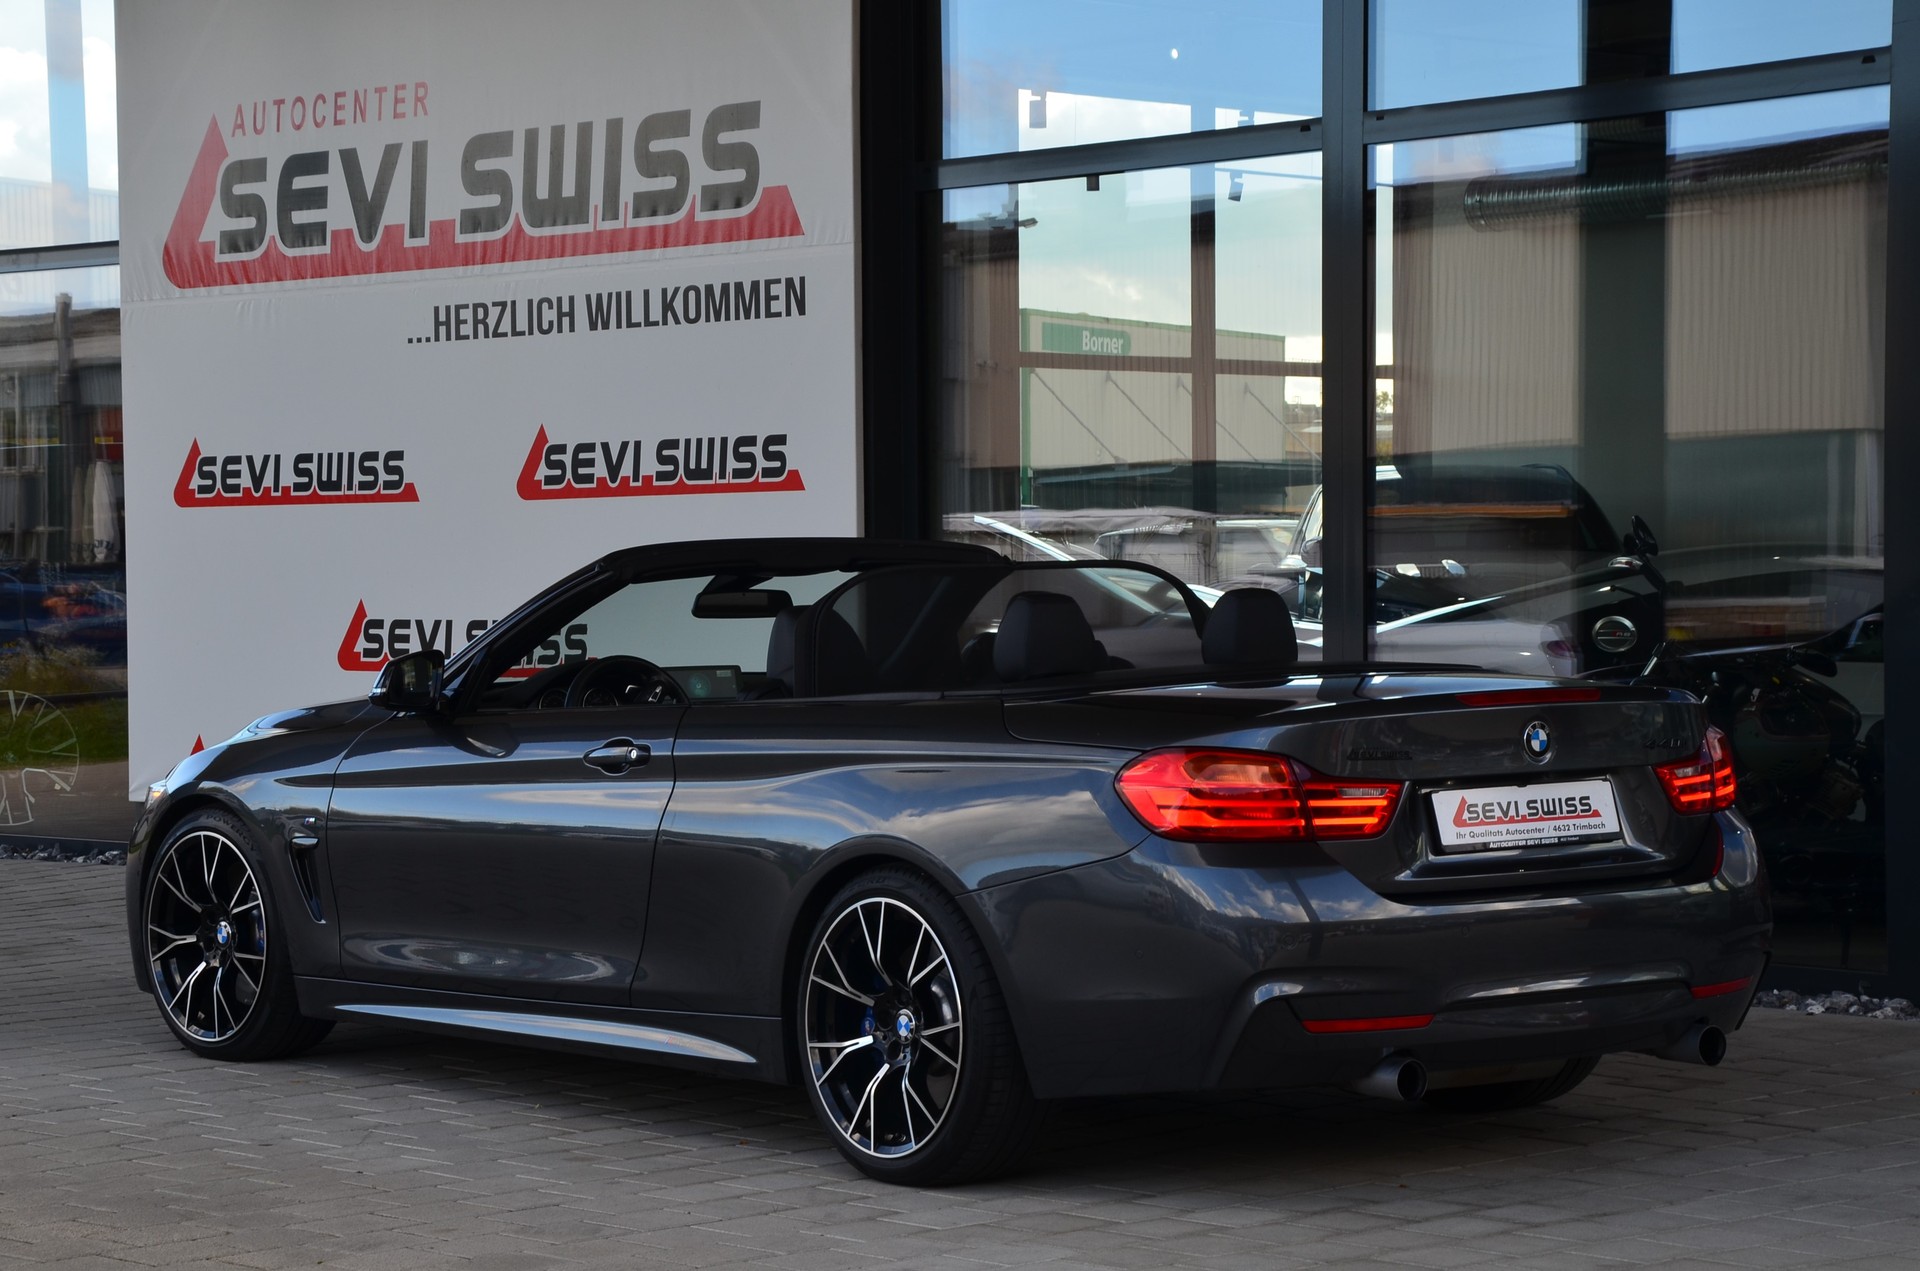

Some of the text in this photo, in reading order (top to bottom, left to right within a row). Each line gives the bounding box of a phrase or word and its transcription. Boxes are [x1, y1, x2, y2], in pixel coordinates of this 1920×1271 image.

[231, 82, 429, 137] AUTOCENTER
[219, 101, 761, 254] SEVI SWISS
[407, 276, 807, 344] ...HERZLICH WILLKOMMEN
[1082, 330, 1124, 353] Borner
[197, 451, 405, 494] SEVI SWISS
[544, 434, 788, 486] SEVI SWISS
[363, 619, 453, 660] SEVI
[1466, 796, 1591, 821] SEVI SWISS
[1456, 831, 1466, 840] Ihr
[1505, 826, 1545, 836] Autocenter
[1552, 824, 1571, 833] 4632
[1573, 822, 1606, 832] Trimbach
